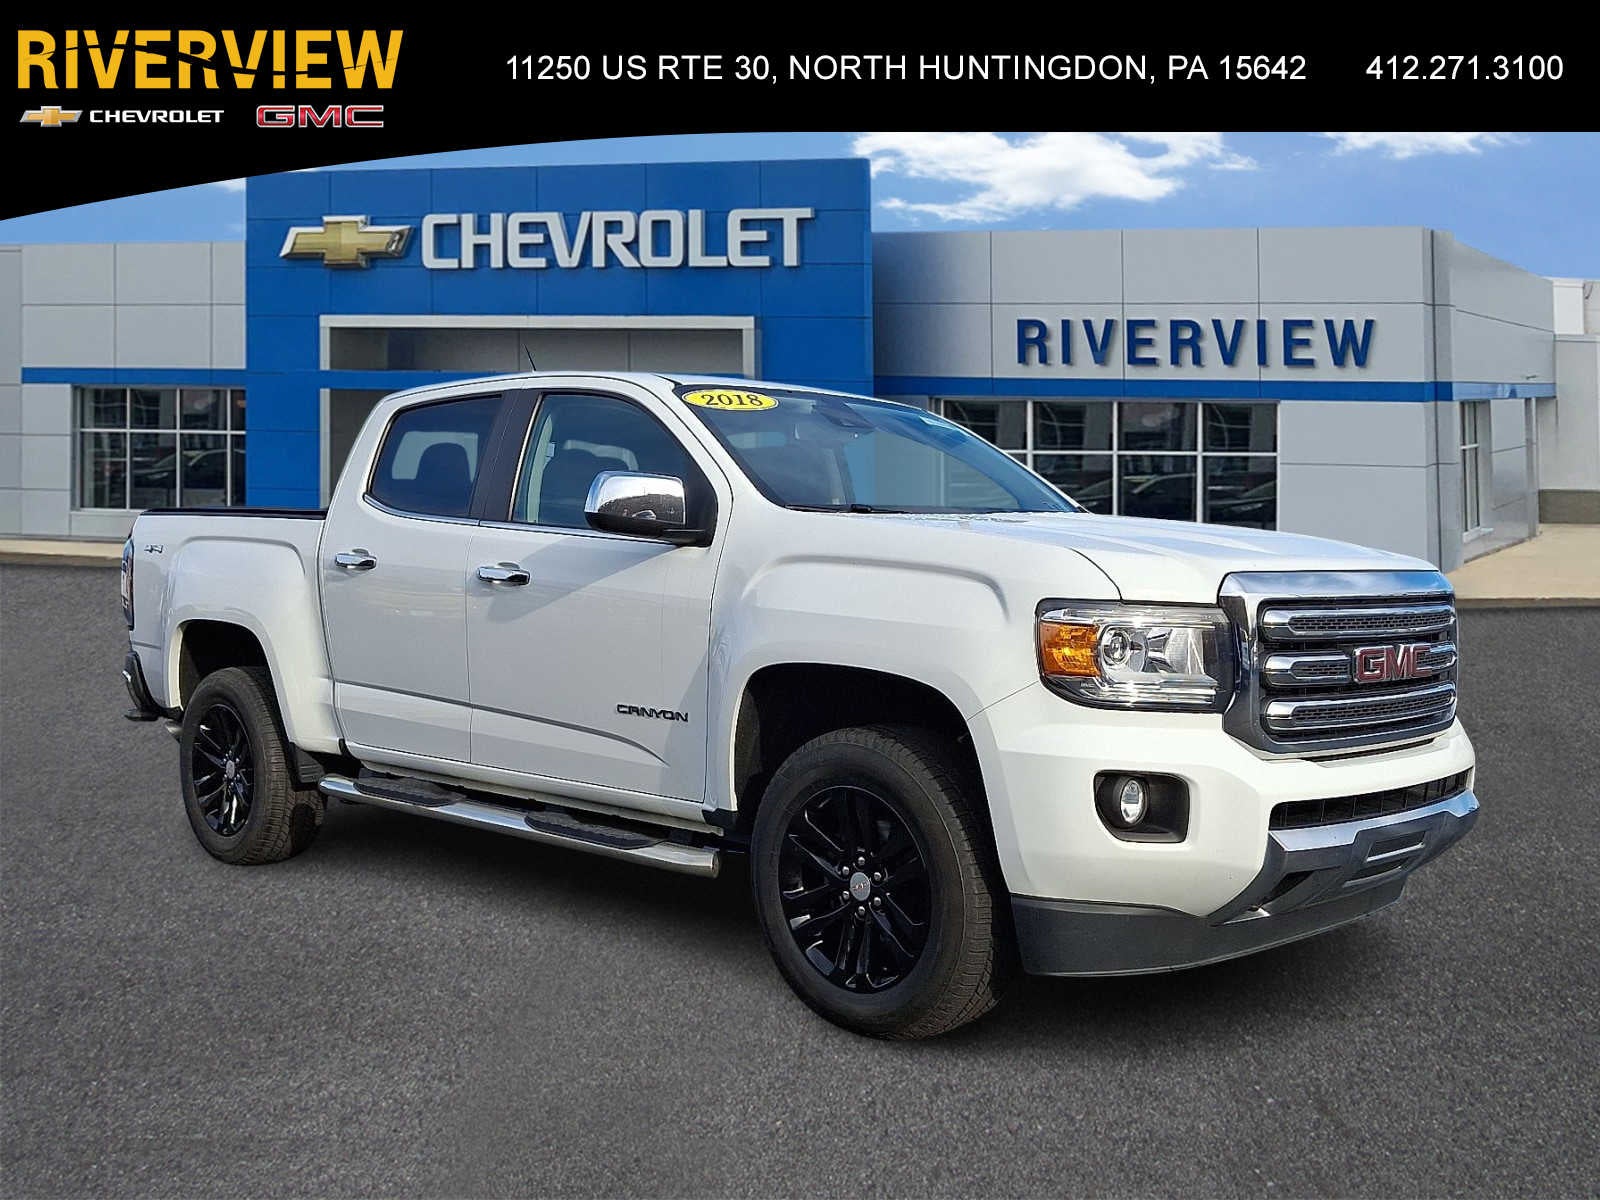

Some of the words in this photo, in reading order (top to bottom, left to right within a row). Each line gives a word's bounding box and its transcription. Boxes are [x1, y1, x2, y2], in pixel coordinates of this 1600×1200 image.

[421, 207, 815, 270] CHEVROLET
[1016, 318, 1378, 368] RIVERVIEW
[700, 393, 764, 407] 2018
[1353, 642, 1433, 684] GMC
[616, 703, 689, 723] CANYON
